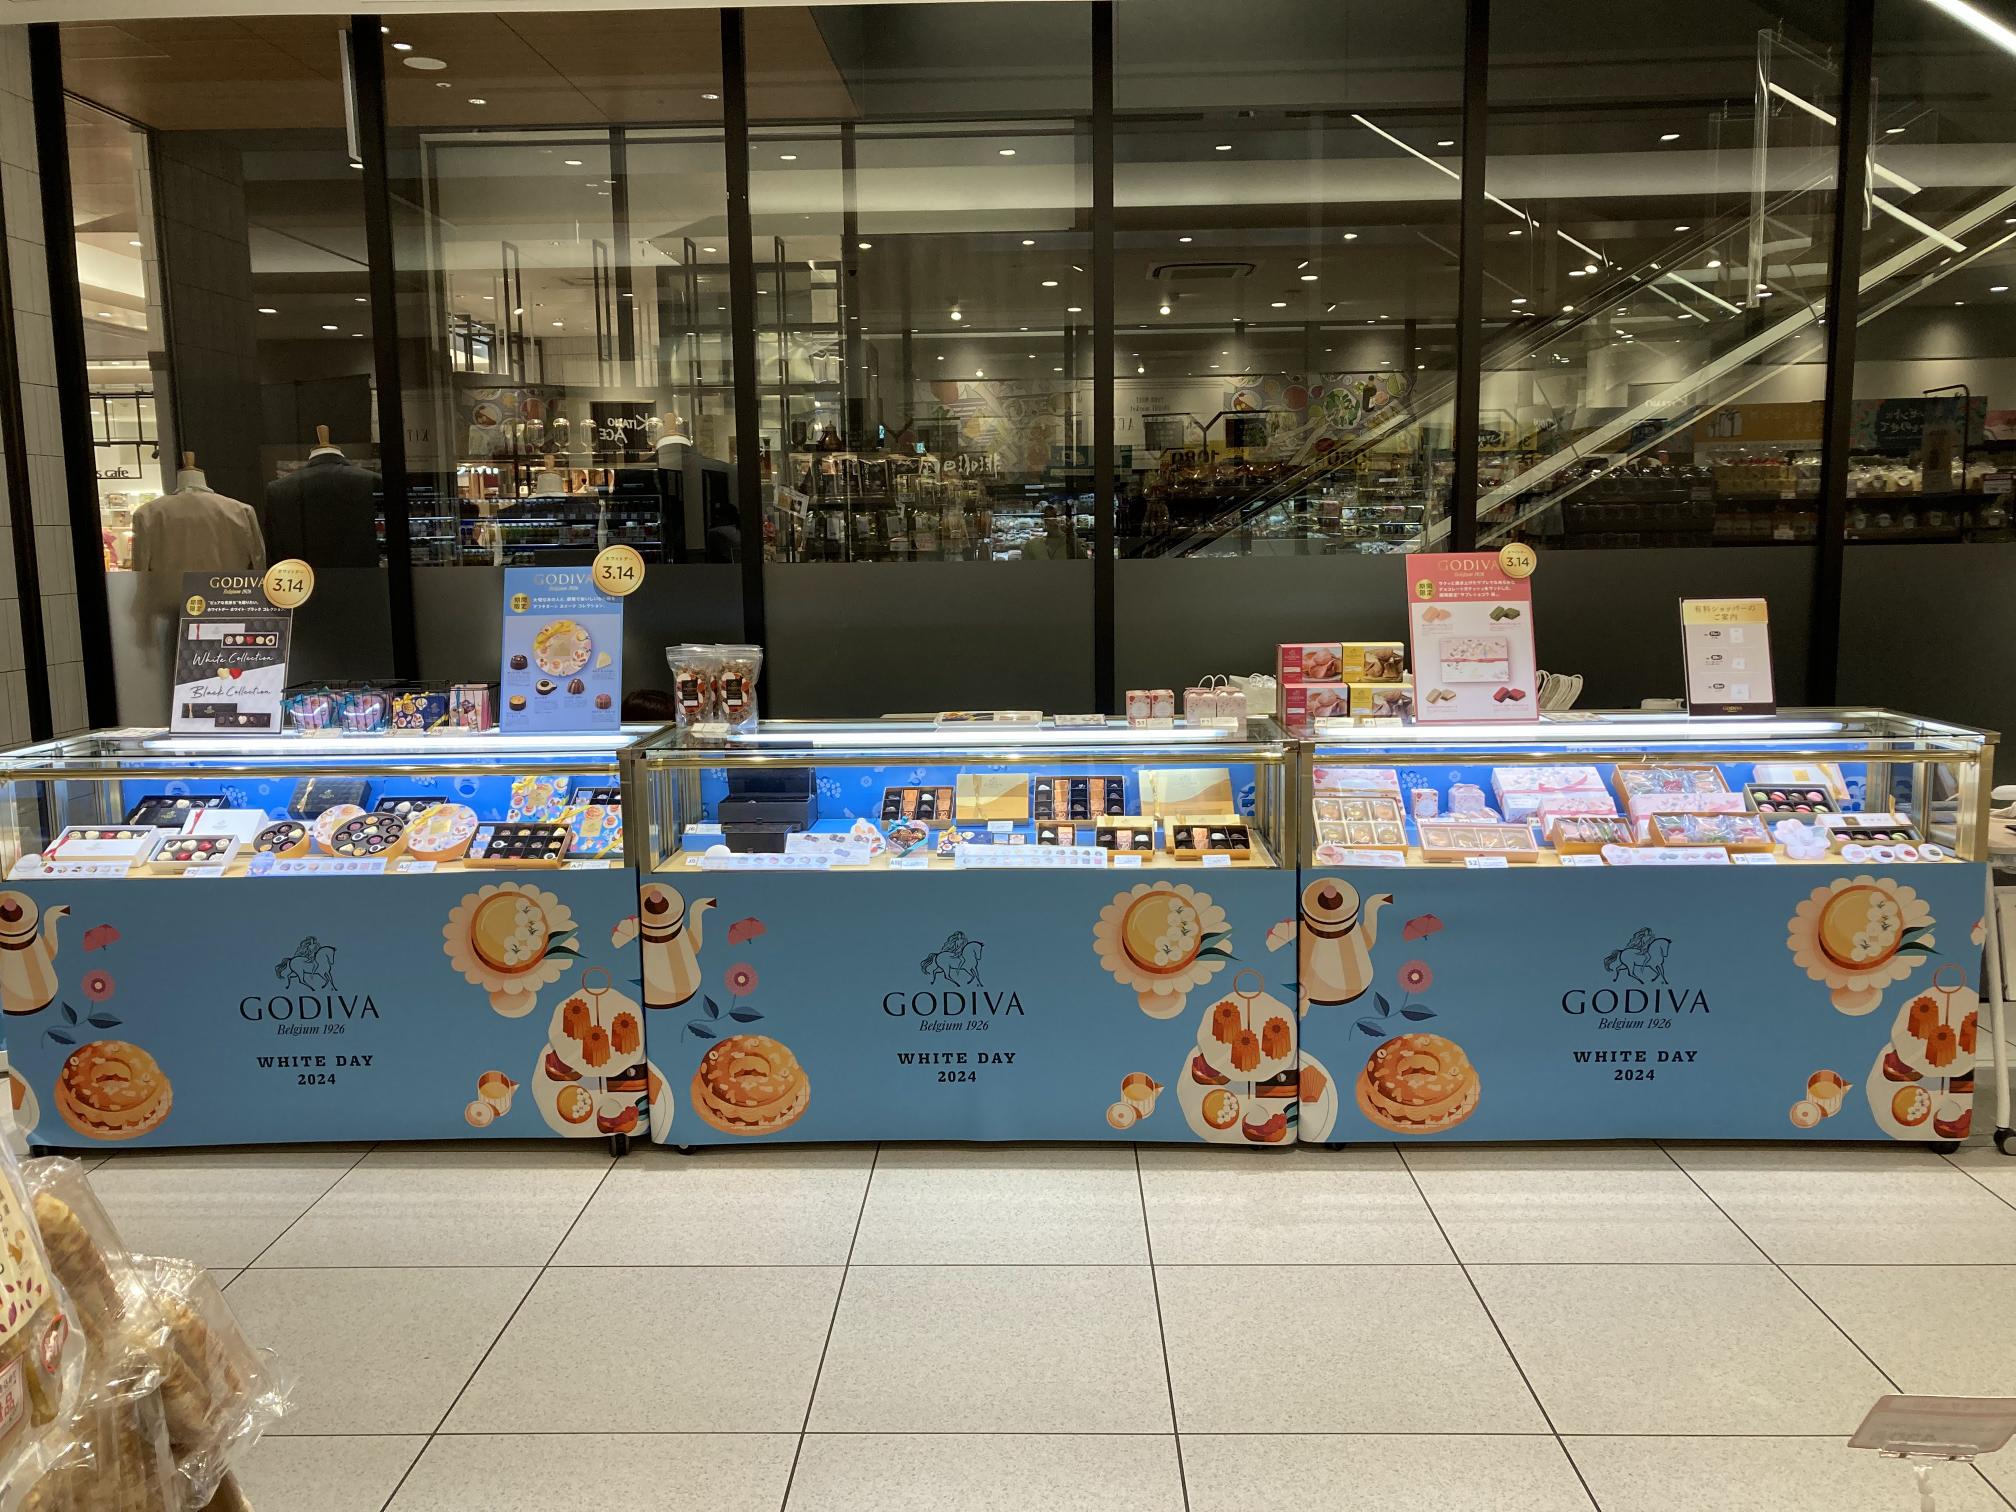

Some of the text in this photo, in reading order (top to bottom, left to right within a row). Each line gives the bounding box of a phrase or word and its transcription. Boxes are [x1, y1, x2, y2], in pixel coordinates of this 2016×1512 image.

[1506, 557, 1530, 567] 3.14
[602, 566, 634, 580] 3.14
[272, 578, 304, 592] 3.14
[193, 650, 274, 665] White Collection
[190, 685, 272, 699] Black Collection
[239, 995, 380, 1021] GODIVA
[882, 991, 1025, 1016] GODIVA
[1561, 988, 1710, 1015] GODIVA
[277, 1023, 346, 1036] Belgium 1926
[919, 1020, 989, 1033] Belgium 1926
[1598, 1017, 1672, 1030] Belgium 1926
[256, 1055, 373, 1068] WHITE DAY
[896, 1052, 1017, 1064] WHITE DAY
[1572, 1050, 1698, 1063] WHITE DAY
[297, 1073, 336, 1085] 2024
[937, 1070, 977, 1083] 2024
[1614, 1069, 1656, 1081] 2024
